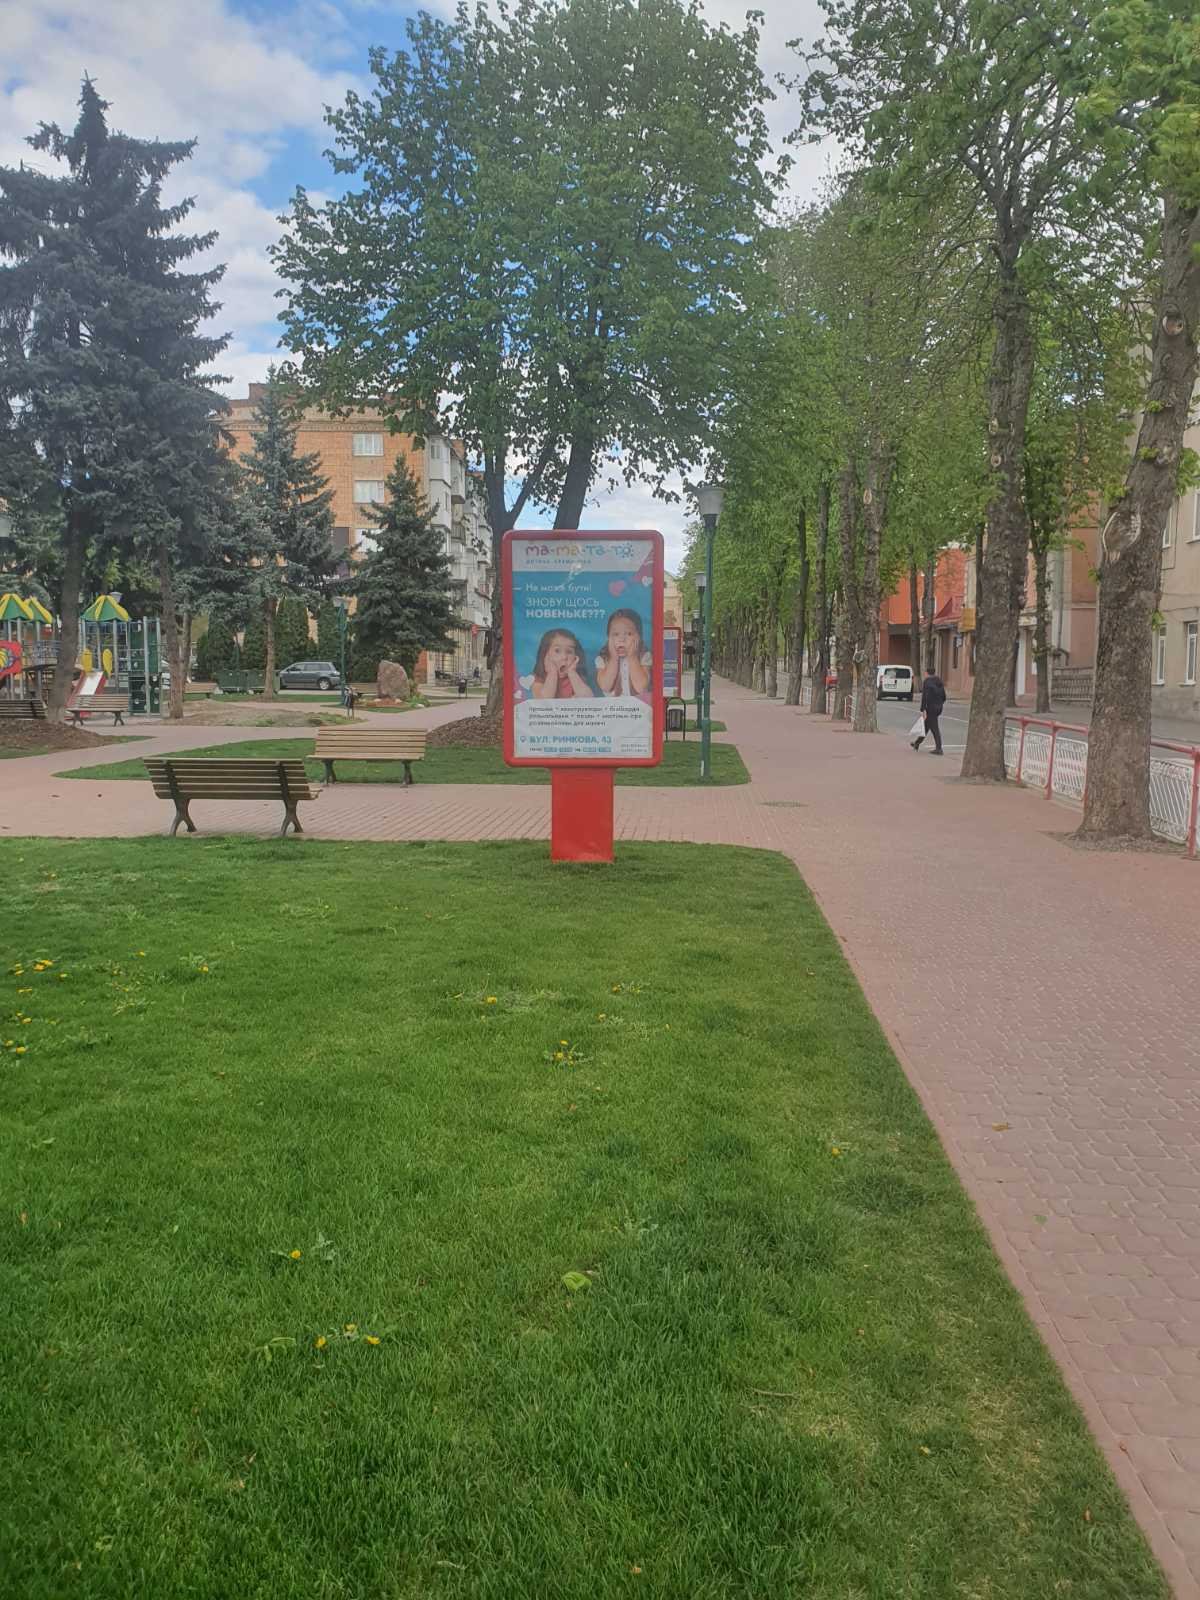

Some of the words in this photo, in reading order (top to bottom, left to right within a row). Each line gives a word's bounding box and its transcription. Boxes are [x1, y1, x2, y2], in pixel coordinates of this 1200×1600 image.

[526, 598, 562, 607] ЗНОВУ
[565, 598, 600, 608] ЩОСЬ
[526, 609, 606, 618] НОВЕНЬКЕ???
